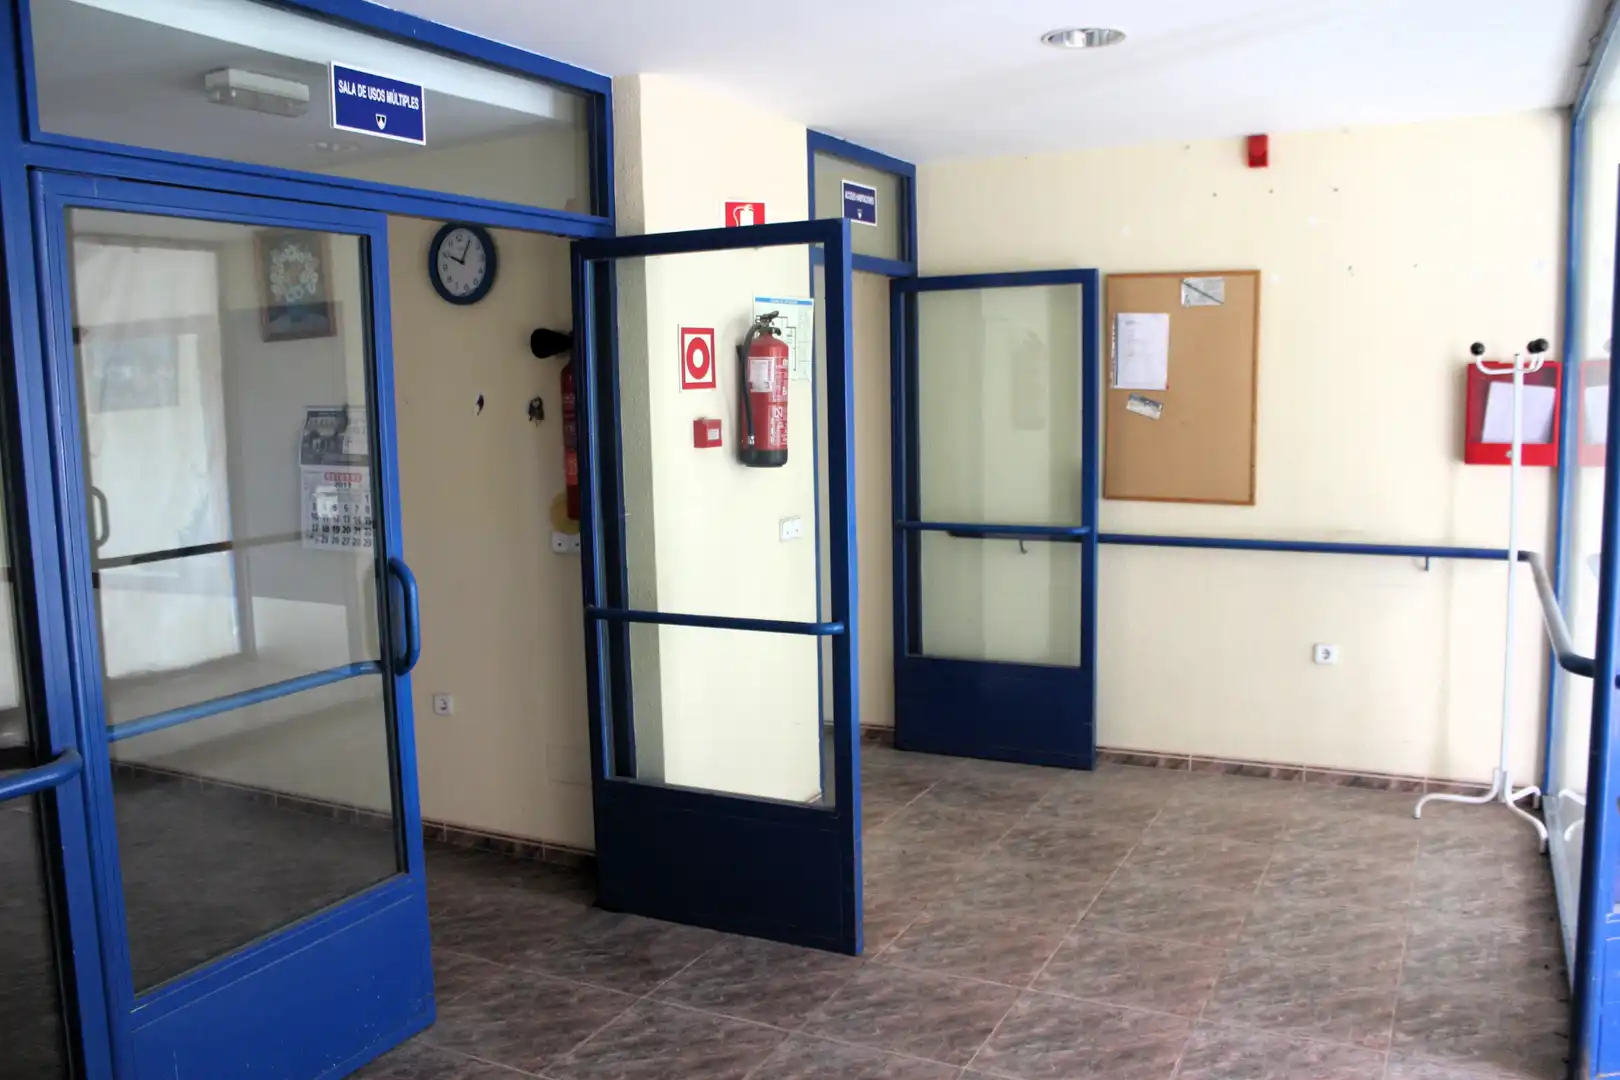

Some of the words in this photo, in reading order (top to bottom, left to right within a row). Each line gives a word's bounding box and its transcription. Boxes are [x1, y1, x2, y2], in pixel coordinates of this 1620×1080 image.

[338, 80, 356, 96] SALA
[357, 83, 367, 98] DE
[367, 86, 385, 103] USOS
[386, 88, 419, 110] MÚLTIPLES
[342, 525, 351, 534] 20
